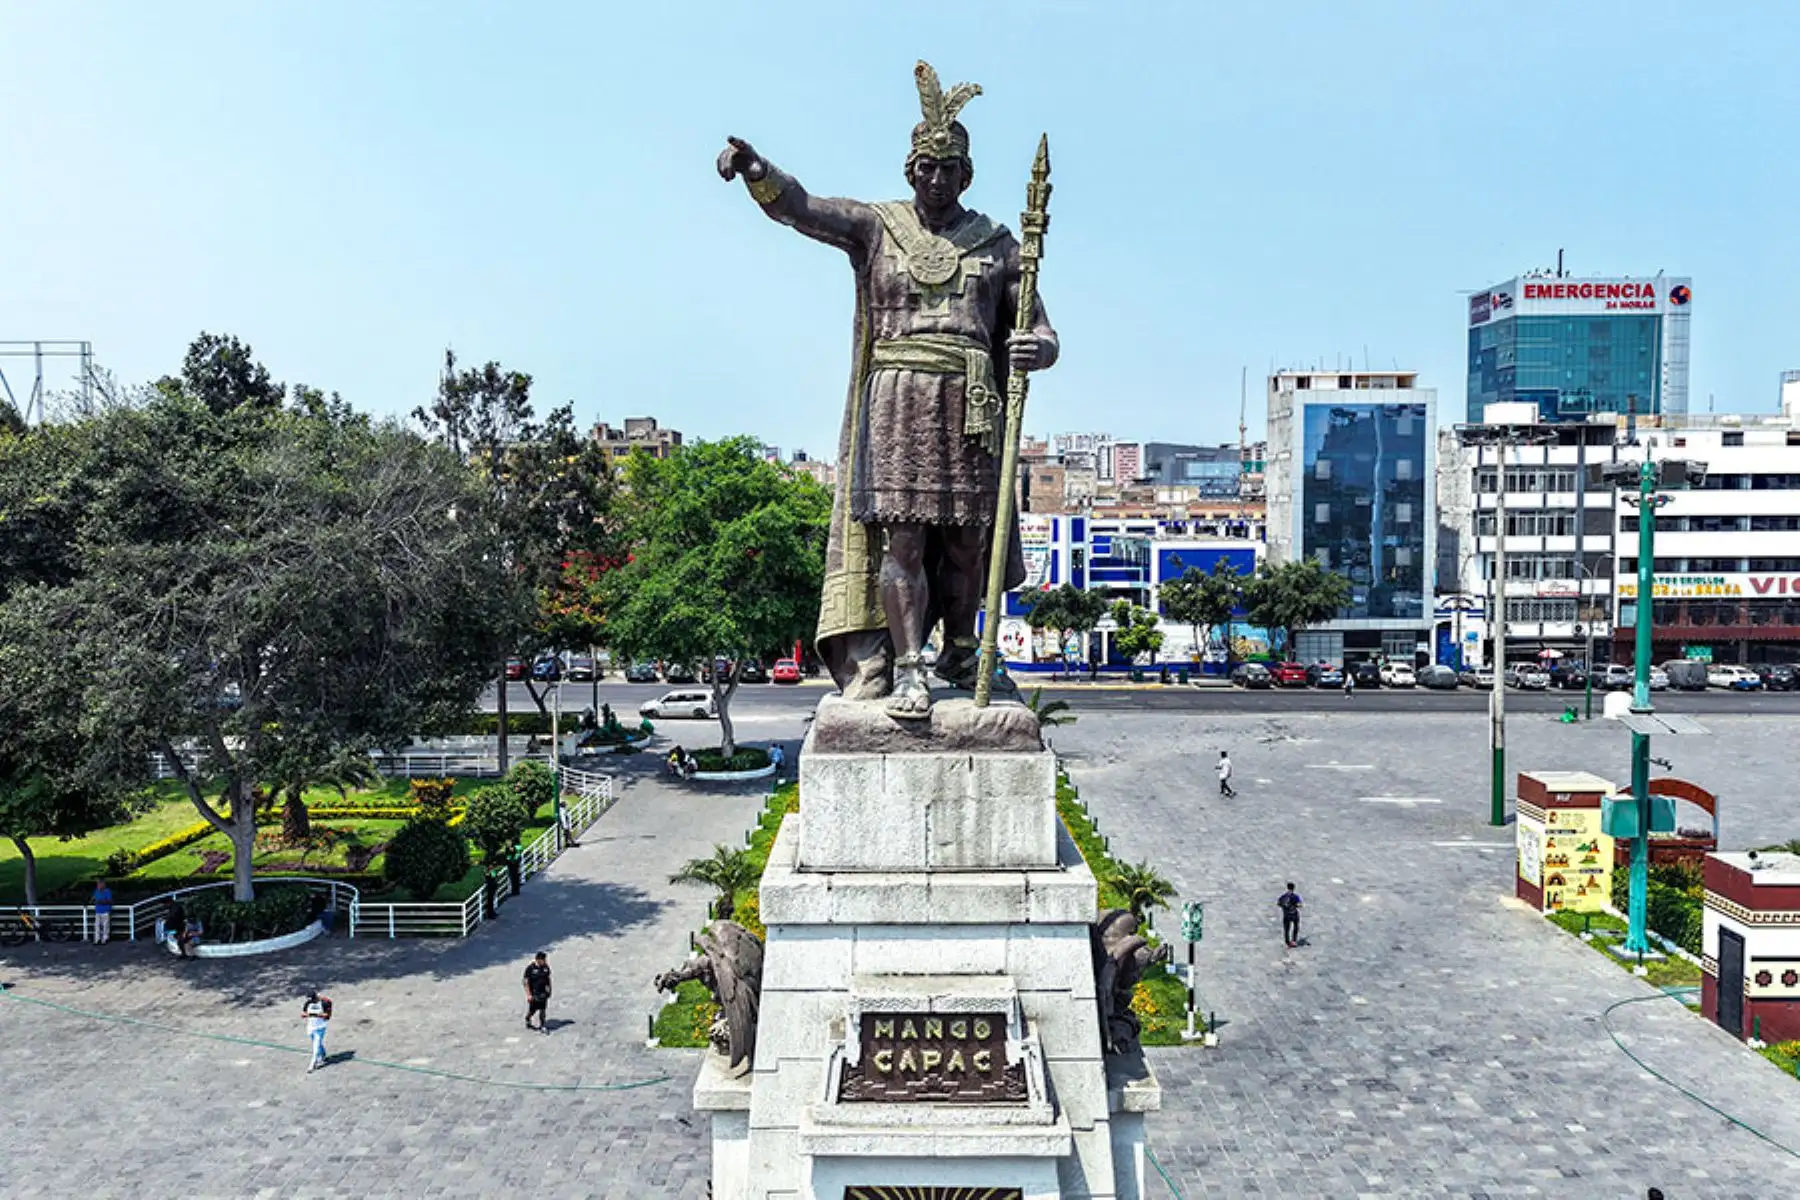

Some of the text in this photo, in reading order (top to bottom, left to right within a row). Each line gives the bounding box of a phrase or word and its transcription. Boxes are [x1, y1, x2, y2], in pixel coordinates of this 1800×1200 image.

[1524, 283, 1655, 299] EMERGENCIA
[1620, 301, 1656, 309] HORAS
[1617, 584, 1669, 596] POOS
[1695, 584, 1742, 595] BRASA
[875, 1018, 991, 1039] MANCO
[874, 1048, 990, 1073] CAPAC
